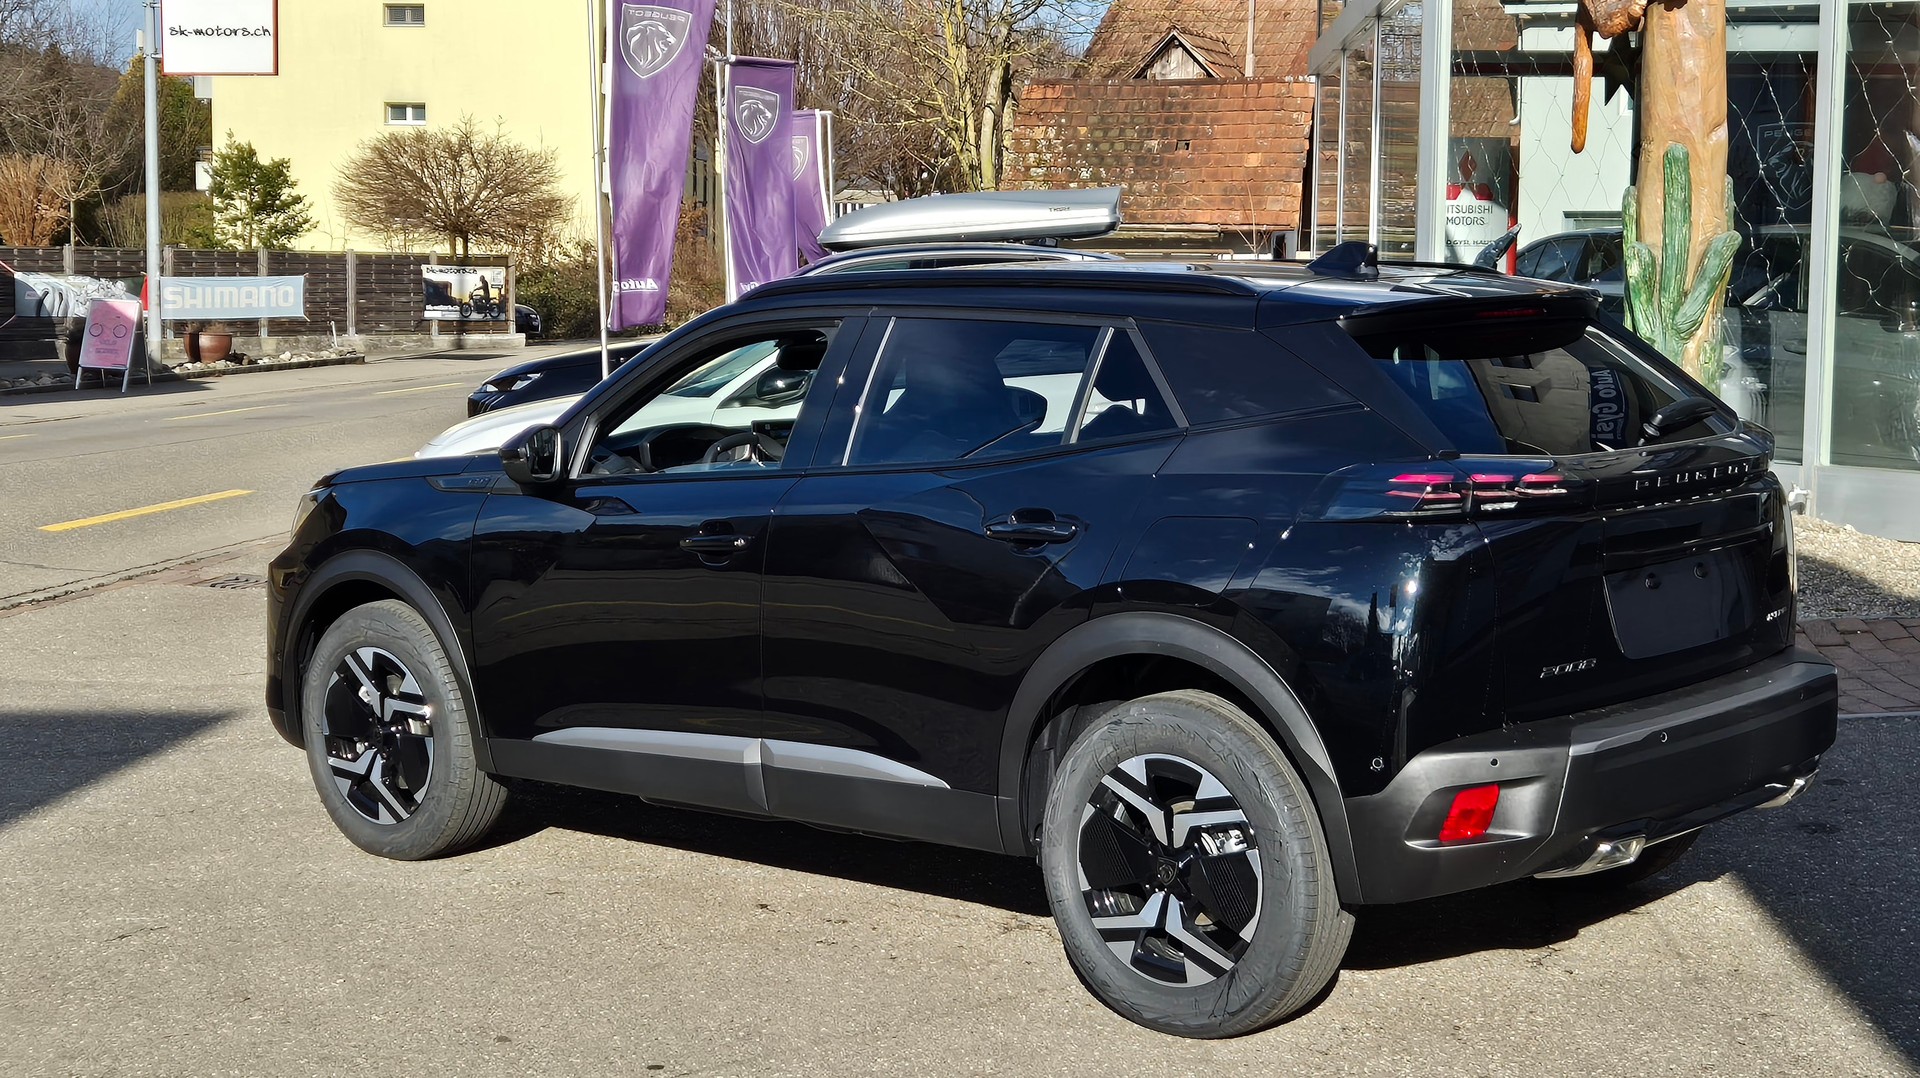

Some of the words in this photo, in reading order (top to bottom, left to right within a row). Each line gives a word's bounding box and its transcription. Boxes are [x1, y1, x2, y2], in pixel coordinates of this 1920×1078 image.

[169, 25, 271, 37] sk-motors.ch
[1446, 204, 1493, 214] ITSUBISHI
[1446, 216, 1485, 226] MOTORS
[163, 285, 295, 309] SHIMANO
[1635, 462, 1749, 491] PEUGEOT
[1540, 658, 1597, 679] 2008
